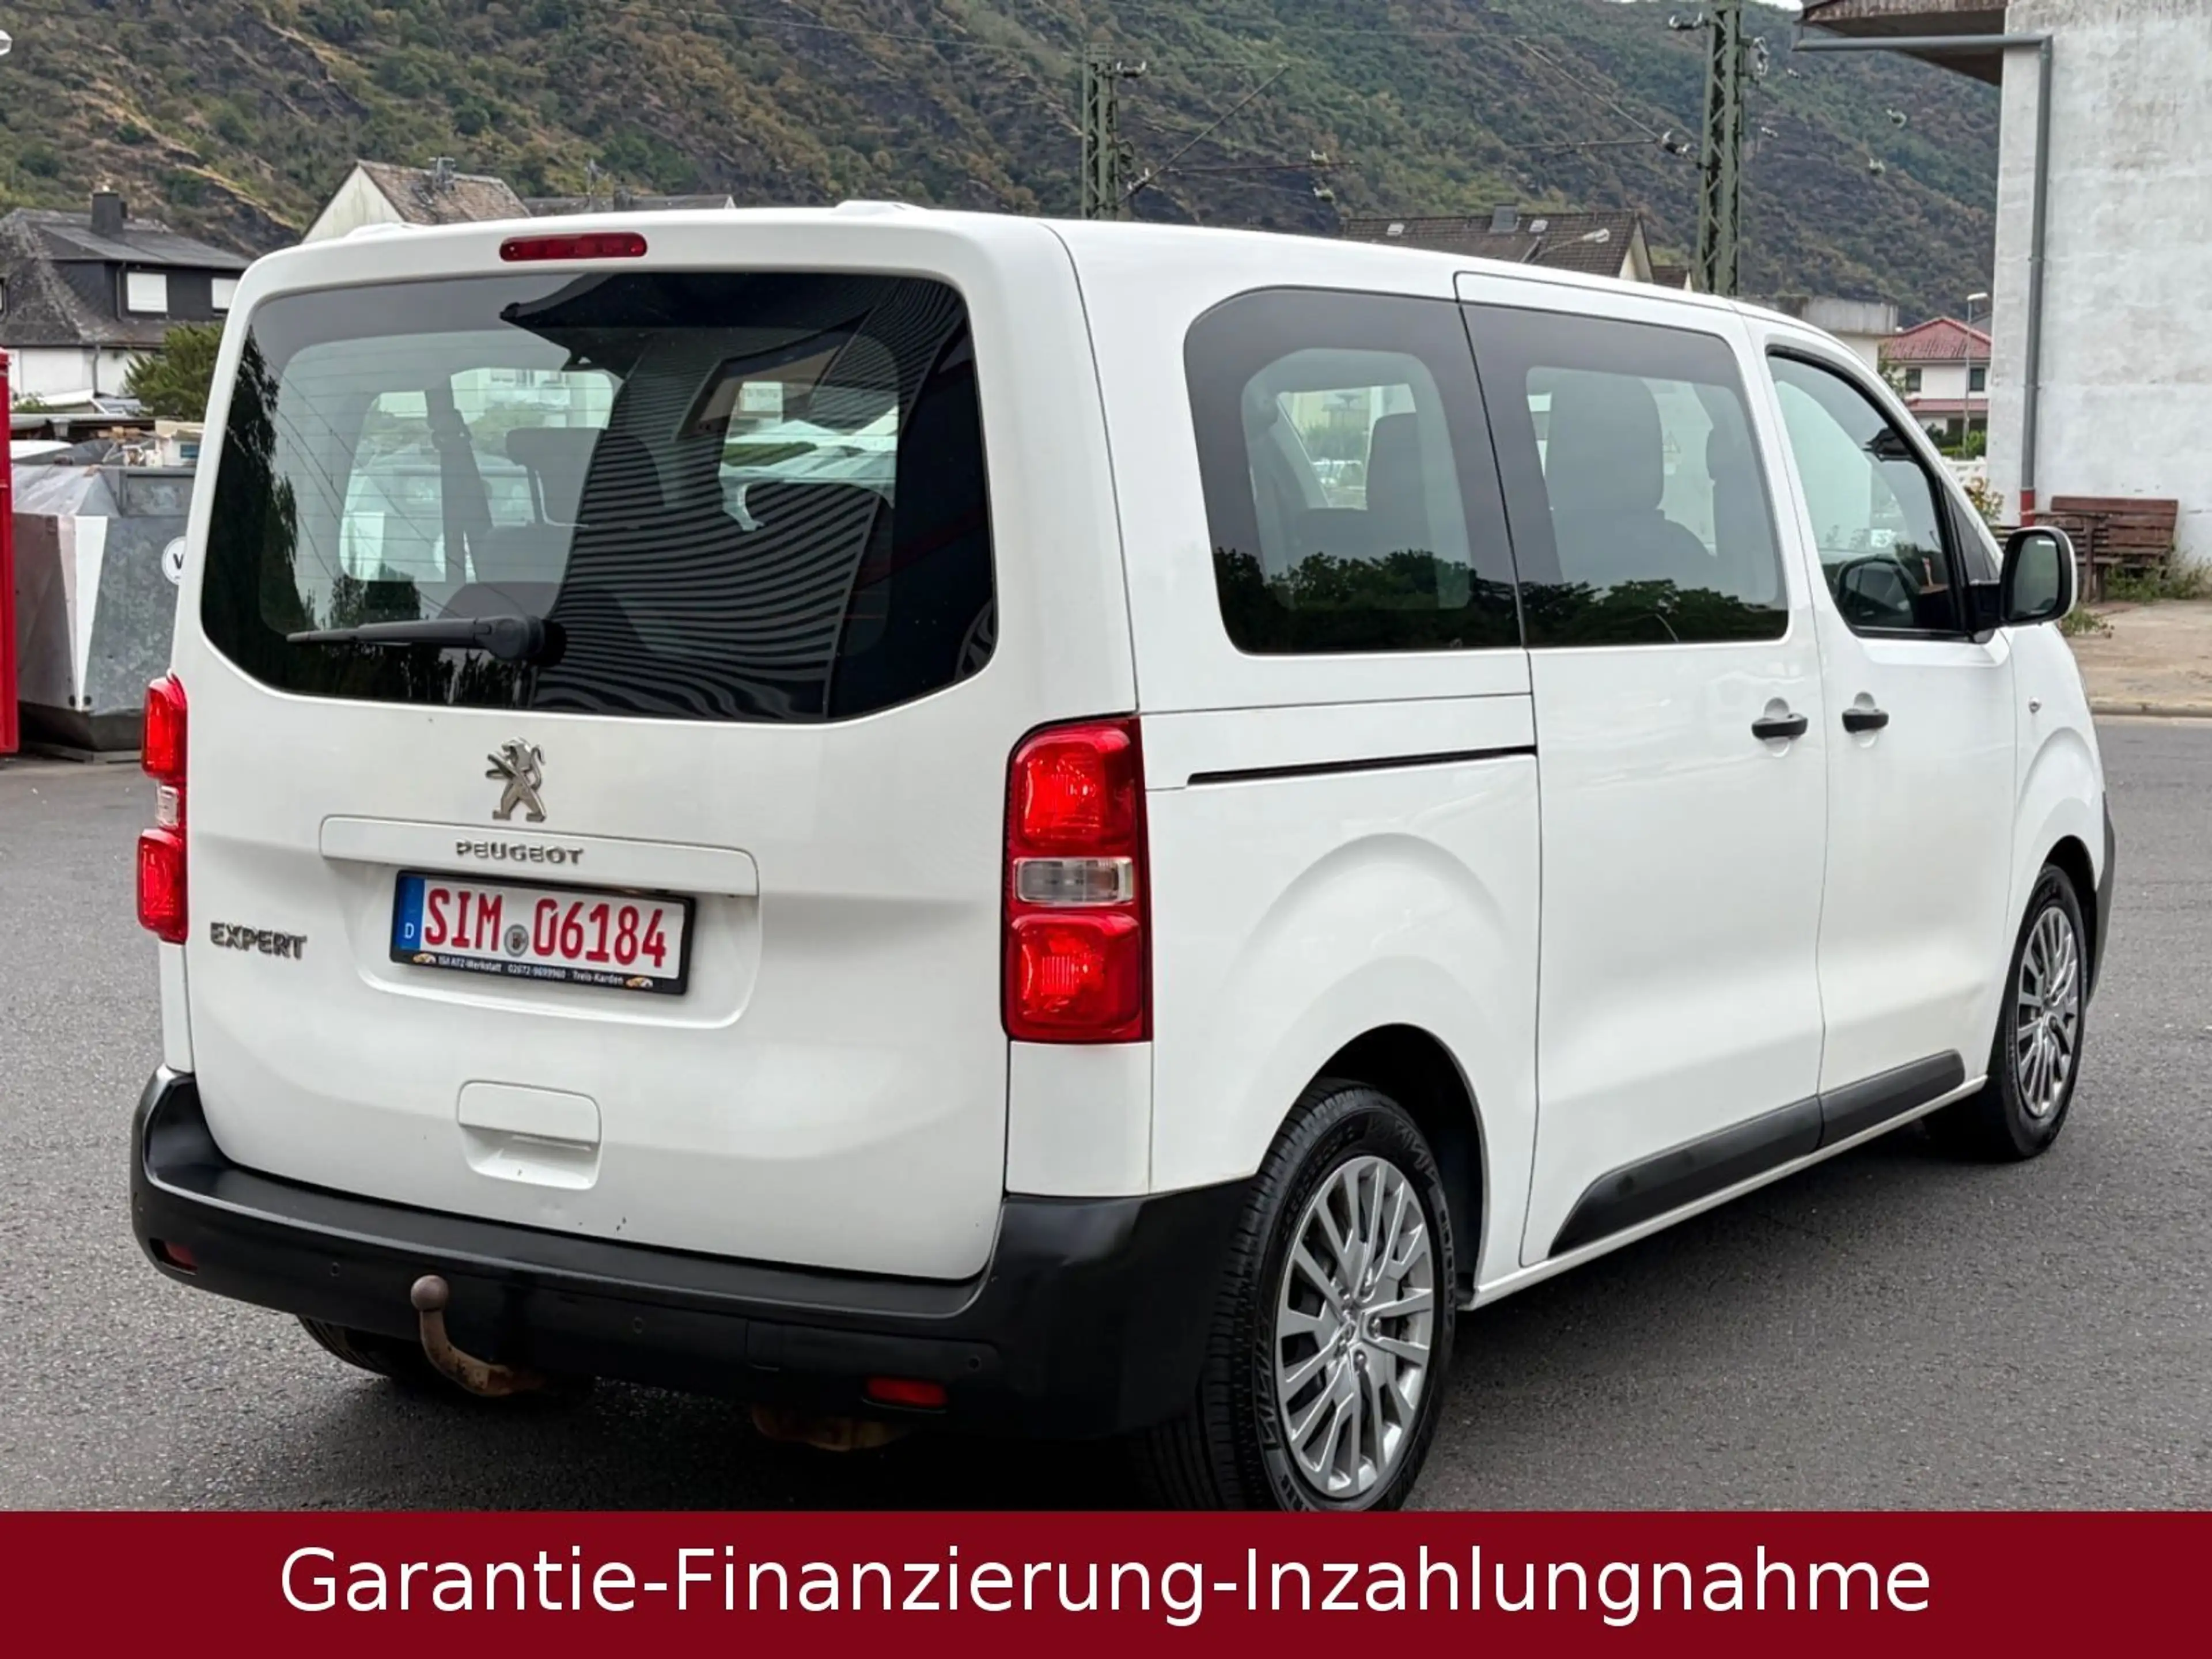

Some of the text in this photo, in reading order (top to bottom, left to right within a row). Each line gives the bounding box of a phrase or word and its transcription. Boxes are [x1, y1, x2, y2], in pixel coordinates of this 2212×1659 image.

[456, 839, 584, 866] PEUGEOT
[210, 921, 308, 961] EXPERT
[404, 922, 415, 939] D
[424, 888, 666, 968] SIM 06184
